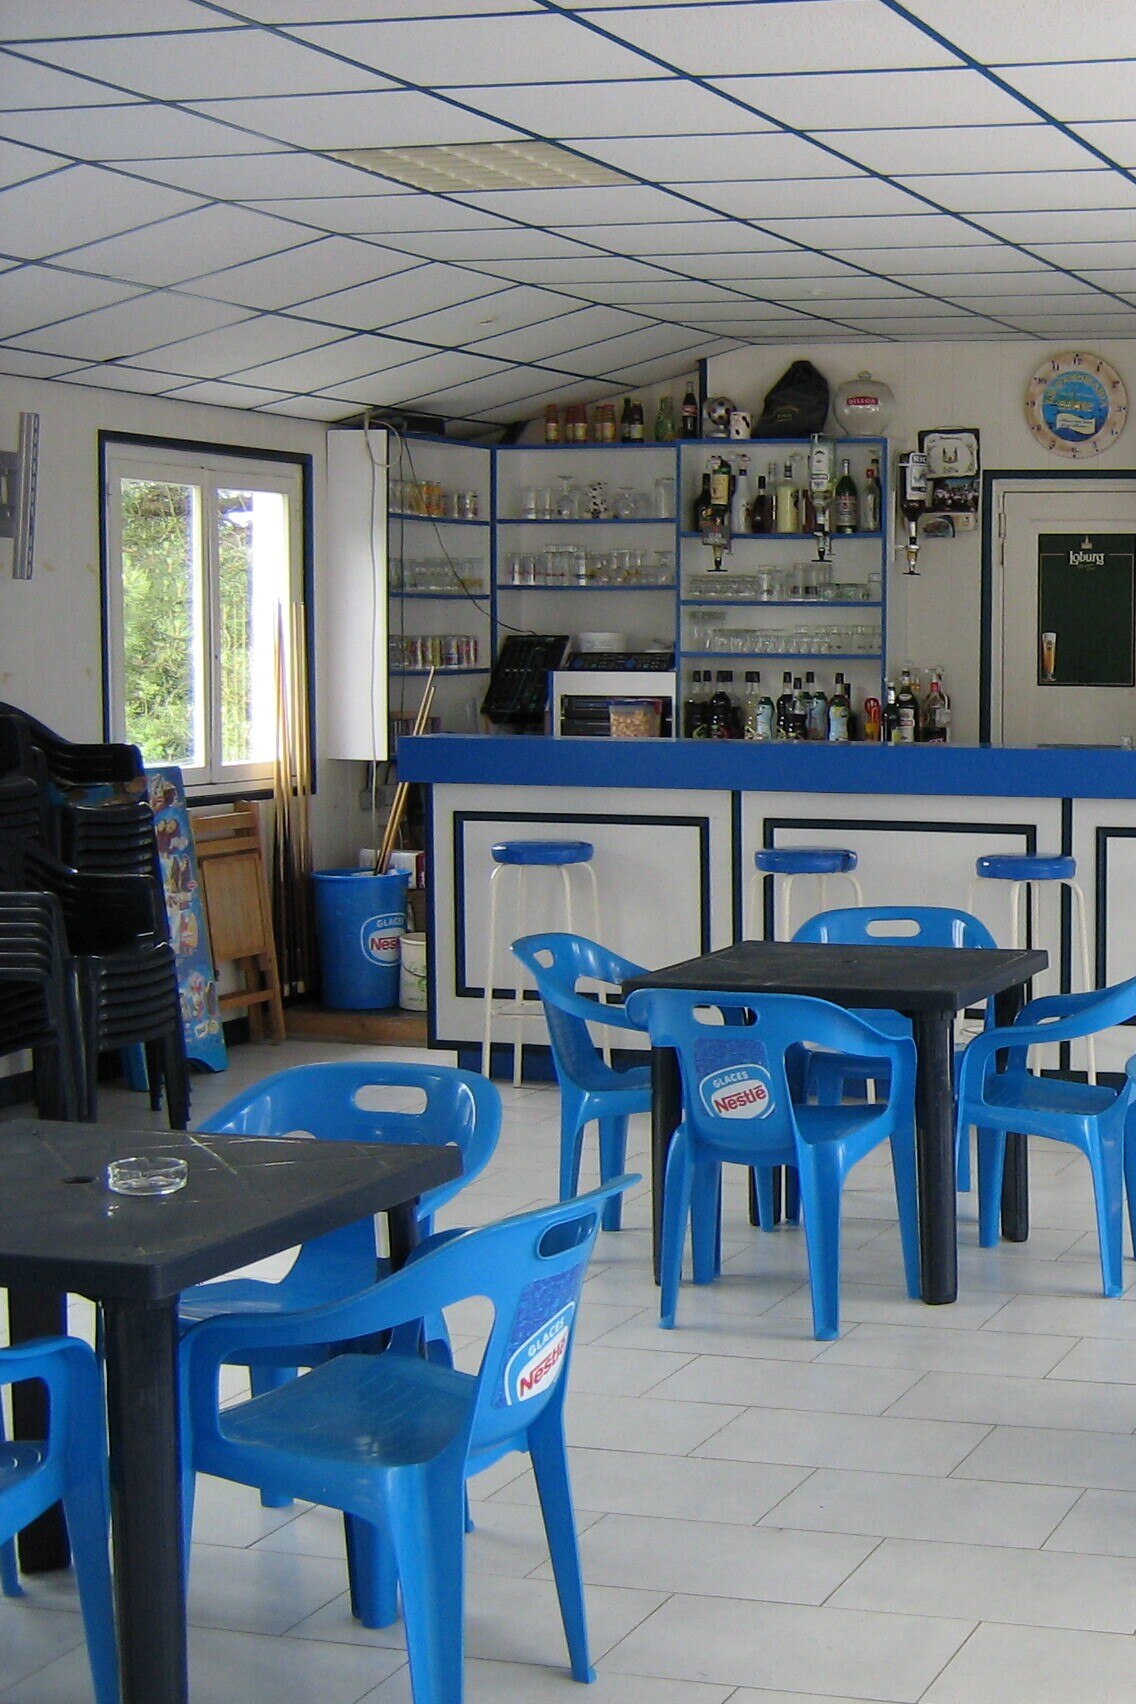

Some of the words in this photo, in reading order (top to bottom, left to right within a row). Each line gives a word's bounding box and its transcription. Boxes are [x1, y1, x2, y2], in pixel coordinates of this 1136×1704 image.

[1069, 550, 1106, 566] Loburg
[713, 1071, 749, 1088] GLACES
[713, 1085, 767, 1114] Nestlé
[527, 1316, 565, 1357] GLACES
